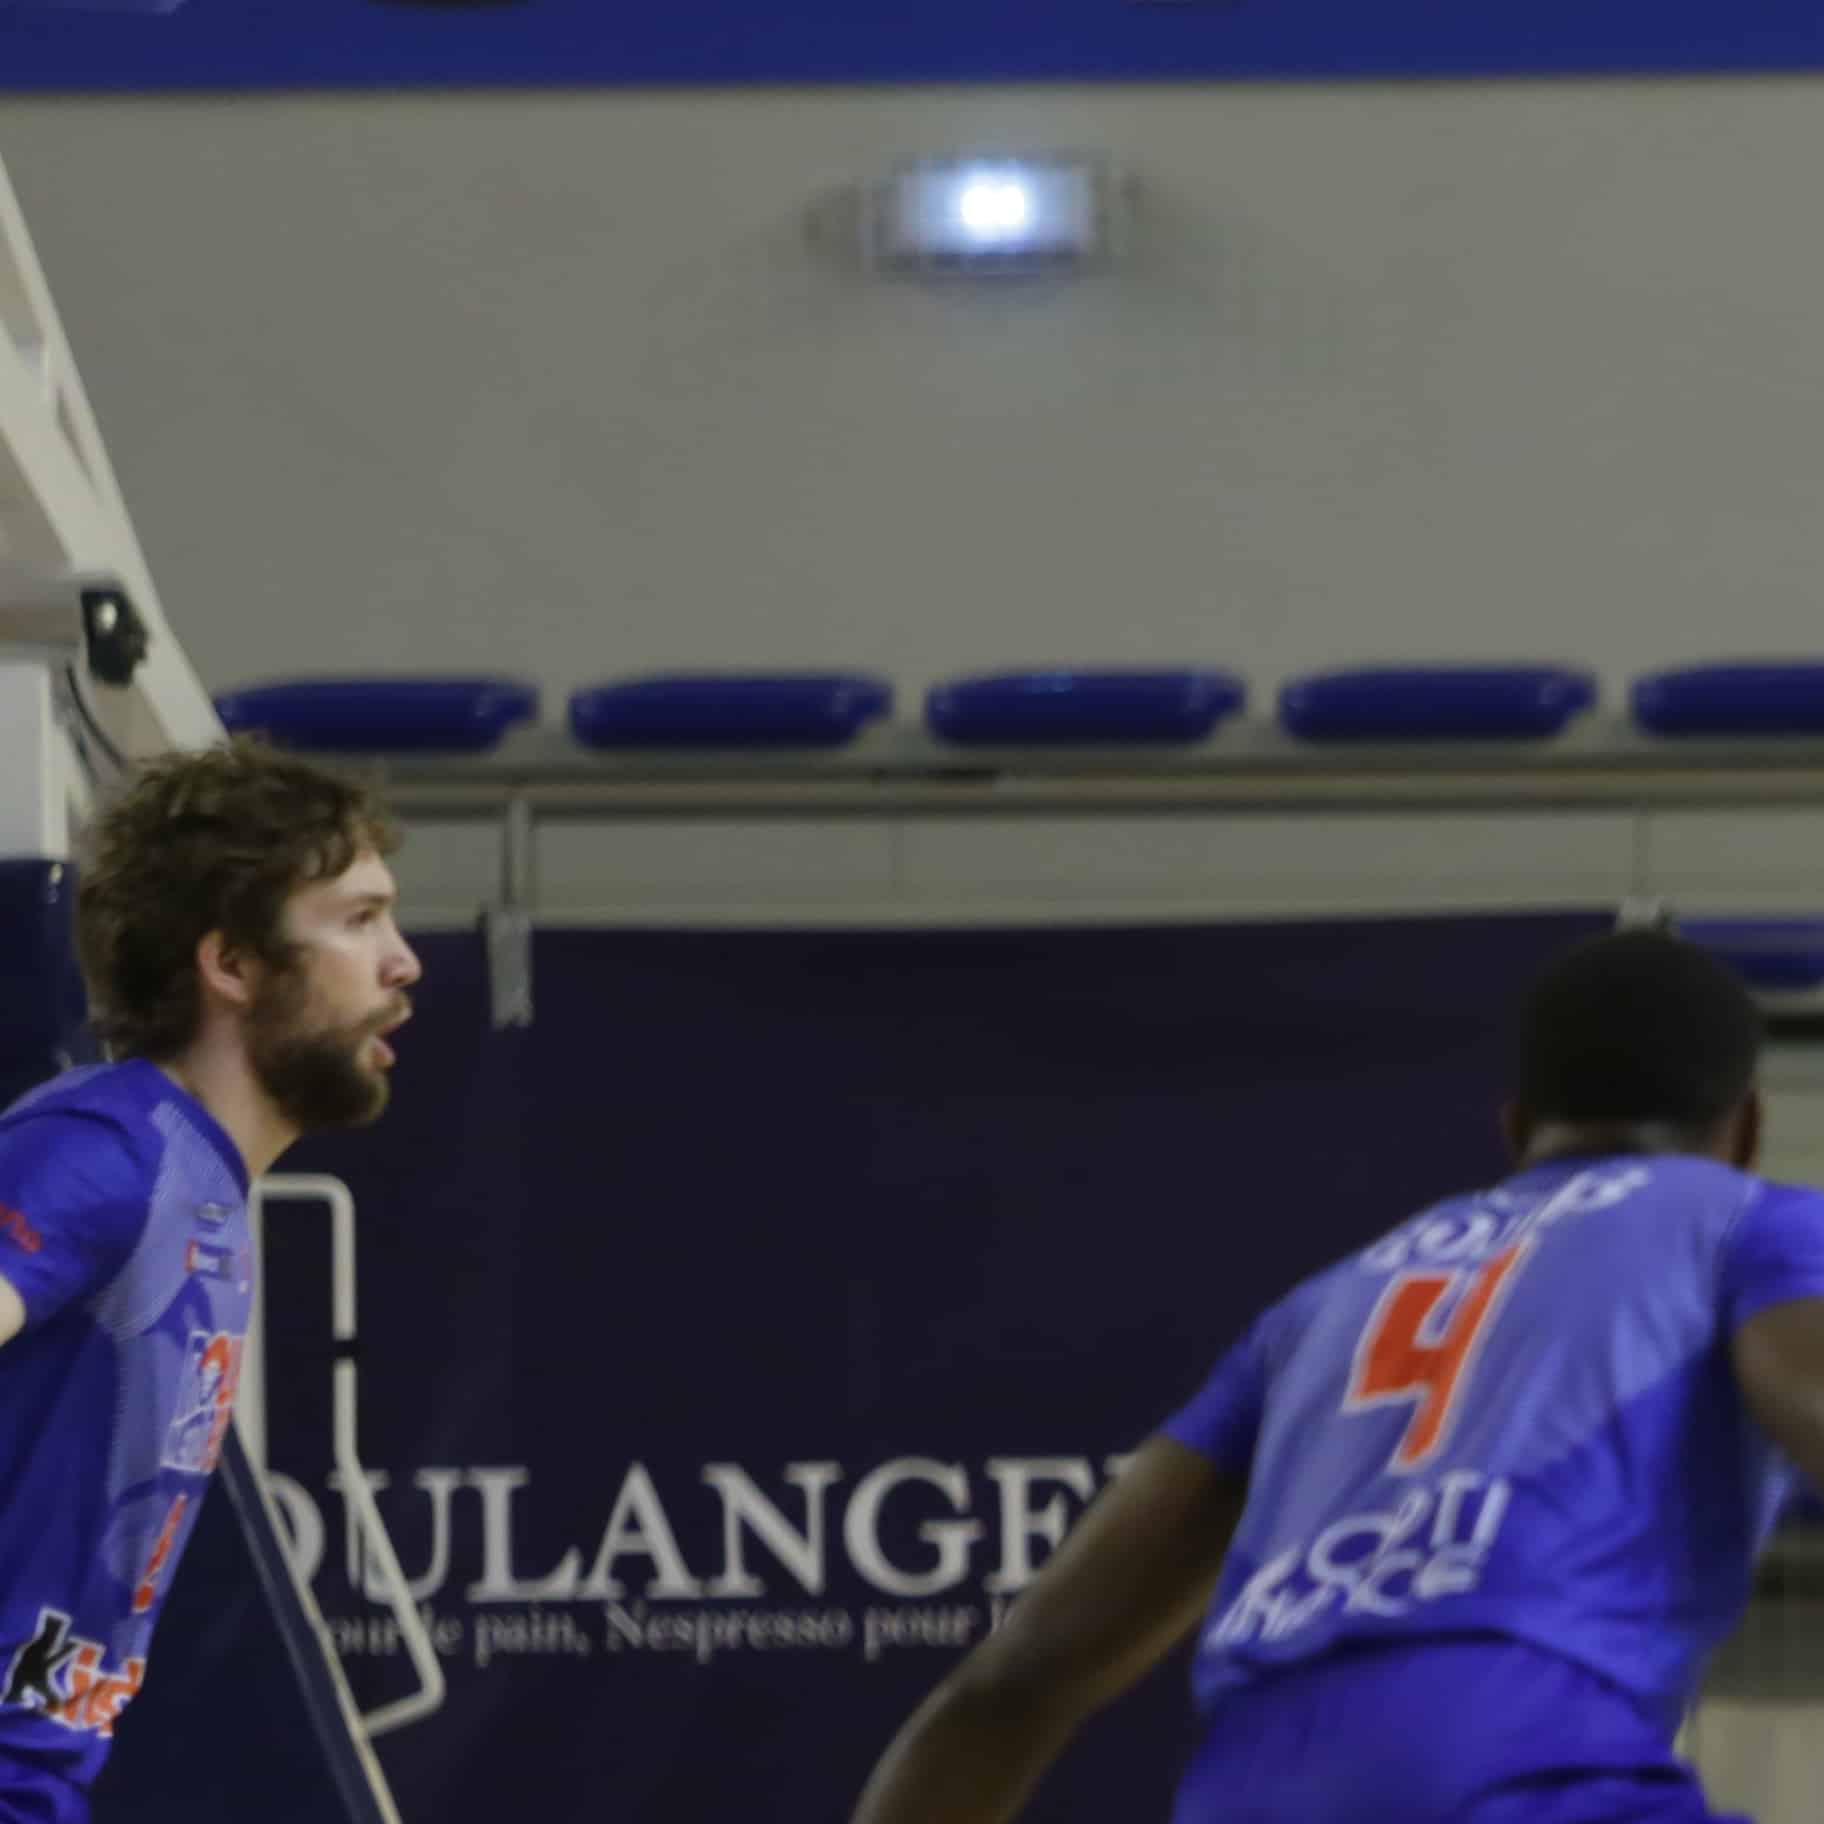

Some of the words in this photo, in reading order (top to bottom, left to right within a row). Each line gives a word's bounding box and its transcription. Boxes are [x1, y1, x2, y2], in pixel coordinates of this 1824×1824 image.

[1343, 1240, 1538, 1474] 4
[262, 1455, 1138, 1602] OULANGE
[606, 1599, 854, 1665] Nespresso
[864, 1606, 977, 1662] pour
